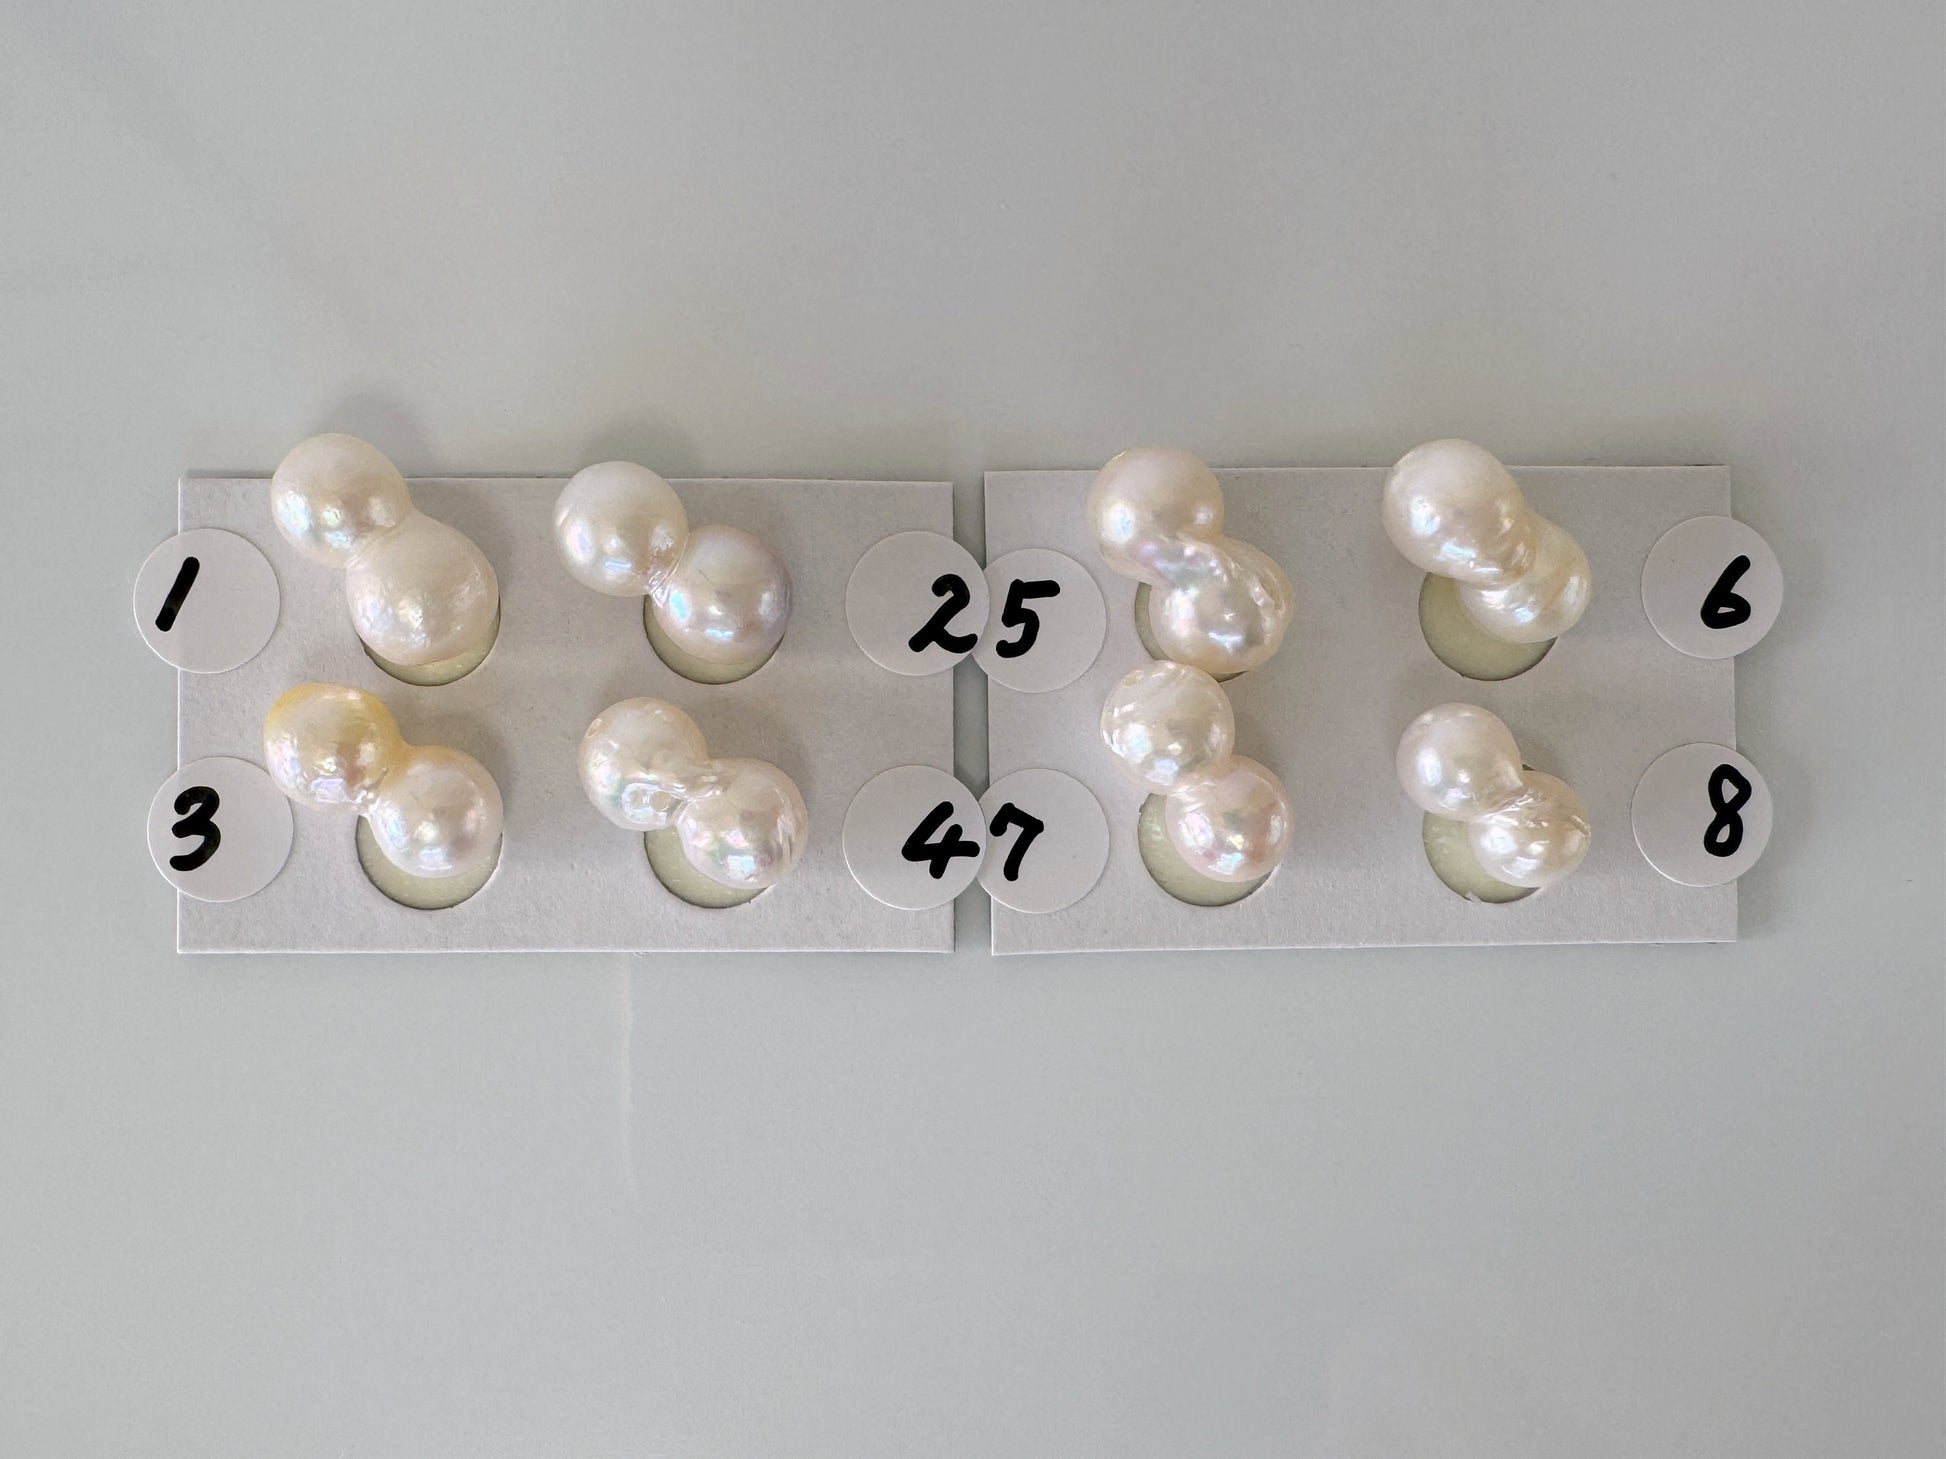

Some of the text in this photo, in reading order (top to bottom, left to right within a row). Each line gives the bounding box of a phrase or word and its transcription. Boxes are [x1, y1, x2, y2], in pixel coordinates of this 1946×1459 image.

[155, 556, 200, 632] 1
[908, 573, 979, 655] 2
[995, 578, 1062, 659] 5
[1700, 554, 1752, 630] 6
[169, 785, 222, 872] 3
[901, 801, 981, 880] 4
[989, 802, 1045, 882] 7
[1703, 763, 1752, 858] 8
